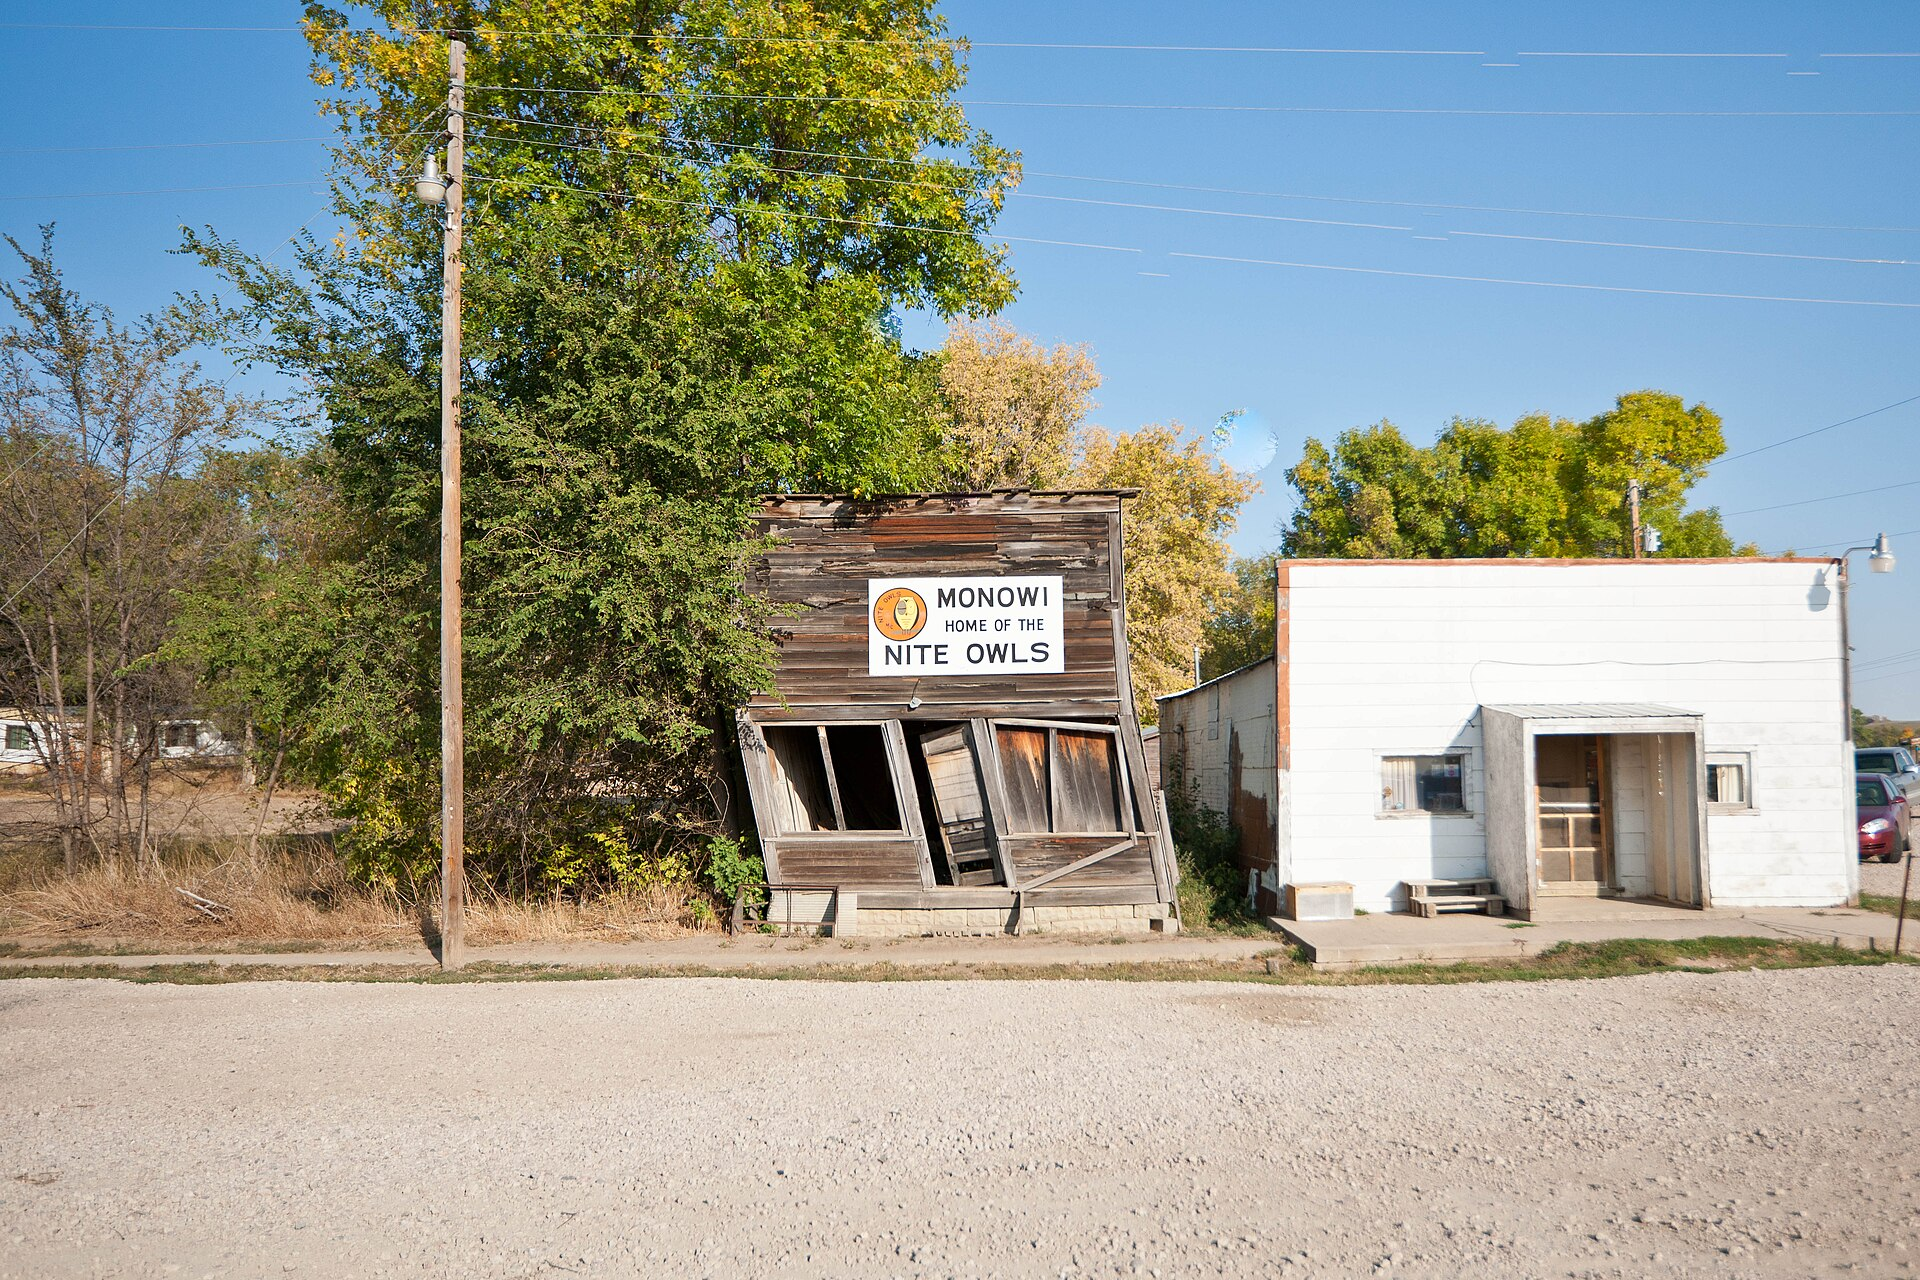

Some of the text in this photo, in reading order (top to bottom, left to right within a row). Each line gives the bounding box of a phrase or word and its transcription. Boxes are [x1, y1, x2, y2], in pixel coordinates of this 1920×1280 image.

[883, 591, 902, 604] OWLS
[937, 586, 1048, 608] MONOWI
[945, 618, 1044, 632] HOME OF THE
[884, 642, 1050, 665] NITE OWLS
